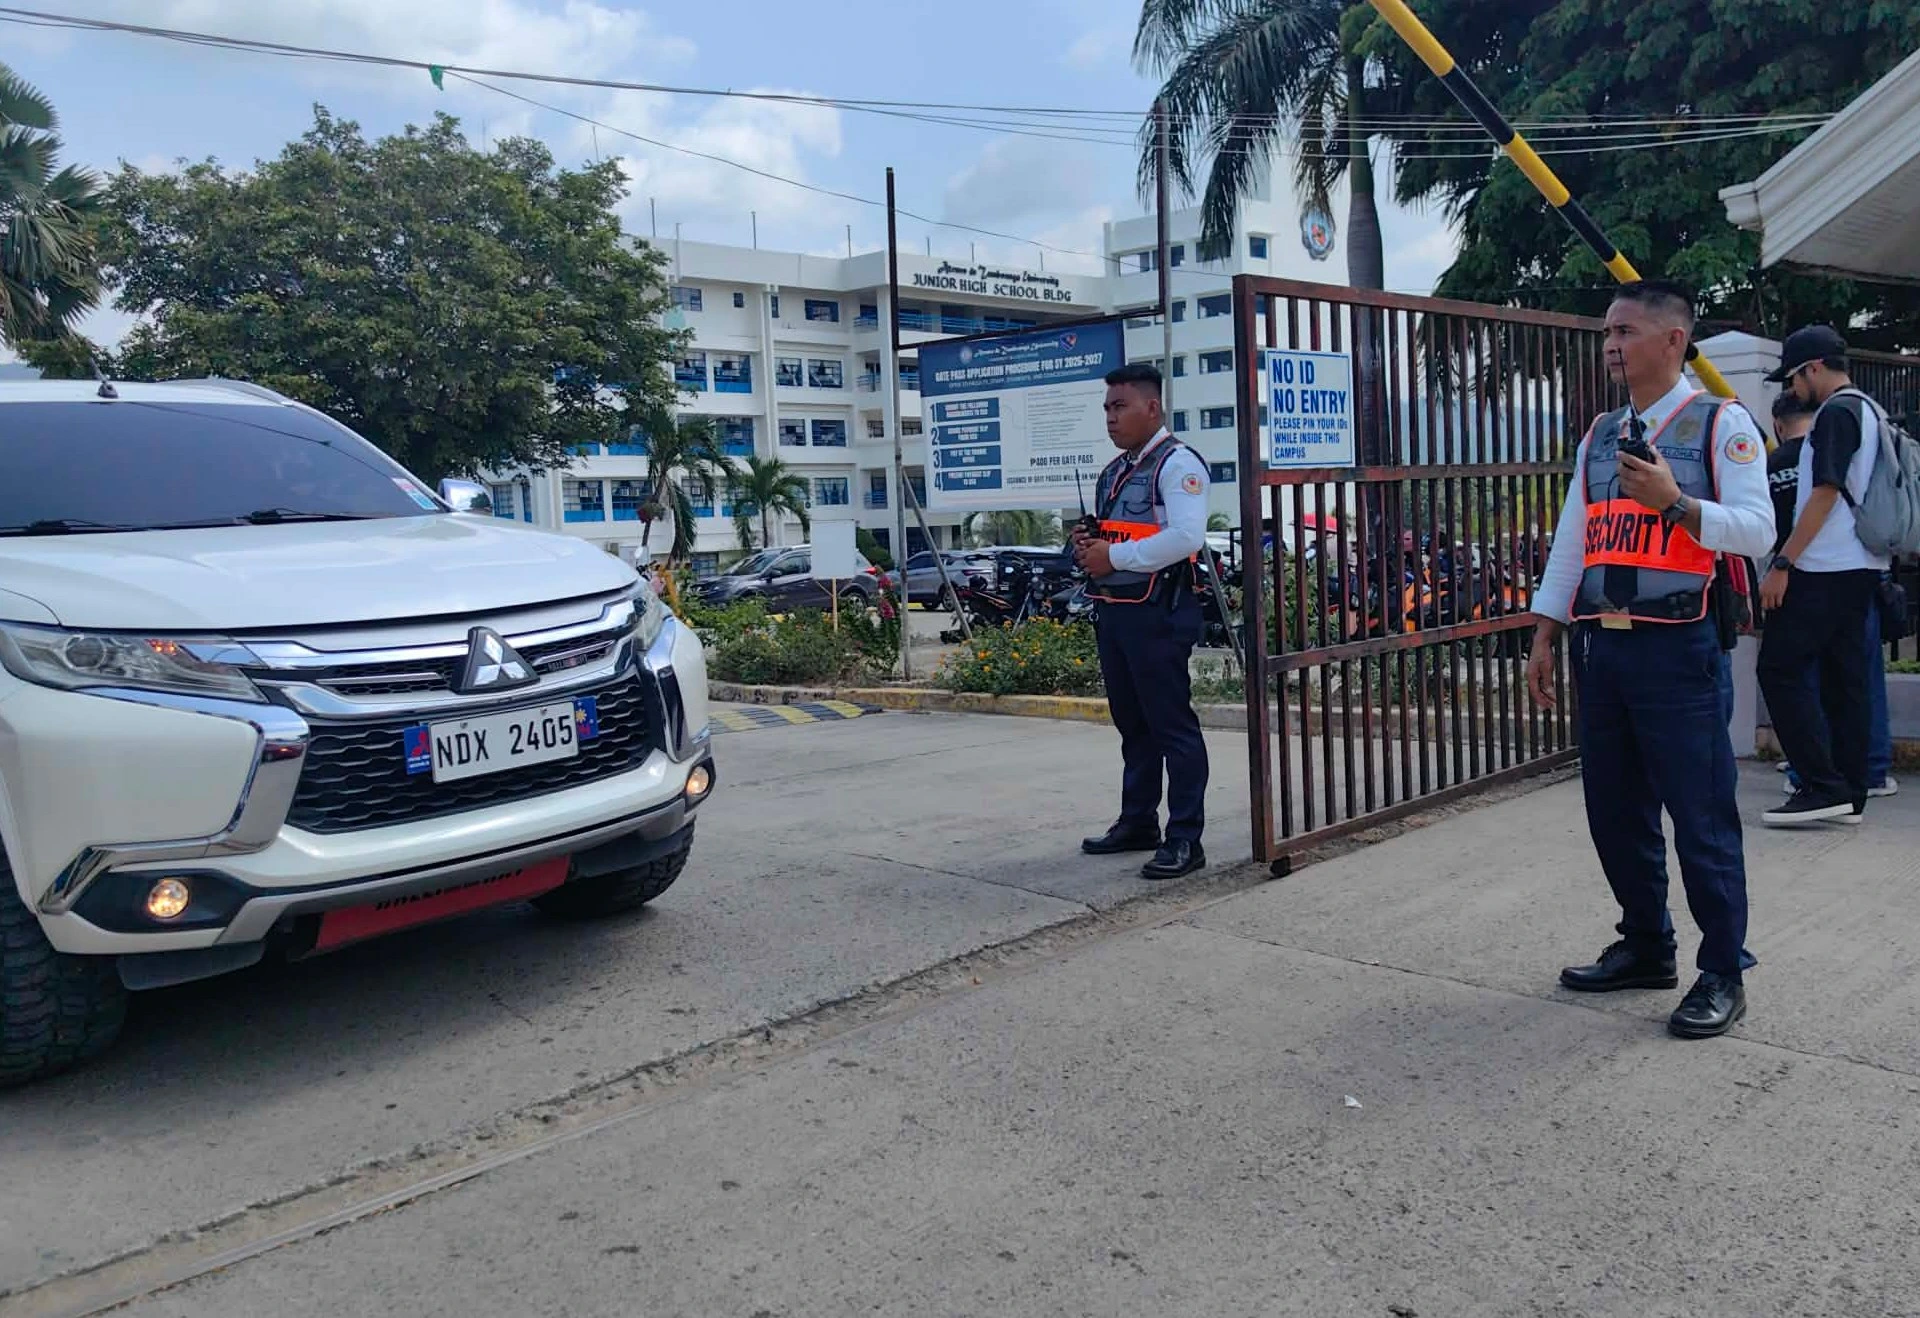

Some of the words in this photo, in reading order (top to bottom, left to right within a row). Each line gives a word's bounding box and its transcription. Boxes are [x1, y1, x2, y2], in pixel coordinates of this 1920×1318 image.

[913, 273, 957, 290] JUNIOR
[960, 278, 987, 293] HIGH
[993, 284, 1040, 299] SCHOOL
[1043, 289, 1072, 302] BLDG
[967, 365, 1004, 379] APPLICATION
[1272, 358, 1294, 384] NO
[1300, 360, 1315, 384] ID
[1273, 388, 1295, 414] NO
[1301, 389, 1347, 414] ENTRY
[1274, 417, 1301, 429] PLEASE
[1303, 418, 1315, 429] PIN
[1318, 419, 1335, 429] YOUR
[1274, 432, 1298, 444] WHILE
[1300, 432, 1323, 444] INSIDE
[1324, 432, 1340, 444] THIS
[1049, 456, 1061, 466] PER
[1061, 455, 1077, 465] GATE
[1078, 454, 1094, 464] PASS
[1274, 447, 1306, 459] CAMPUS
[1584, 512, 1677, 556] SECURITY
[436, 728, 490, 769] NDX
[509, 714, 574, 755] 2405
